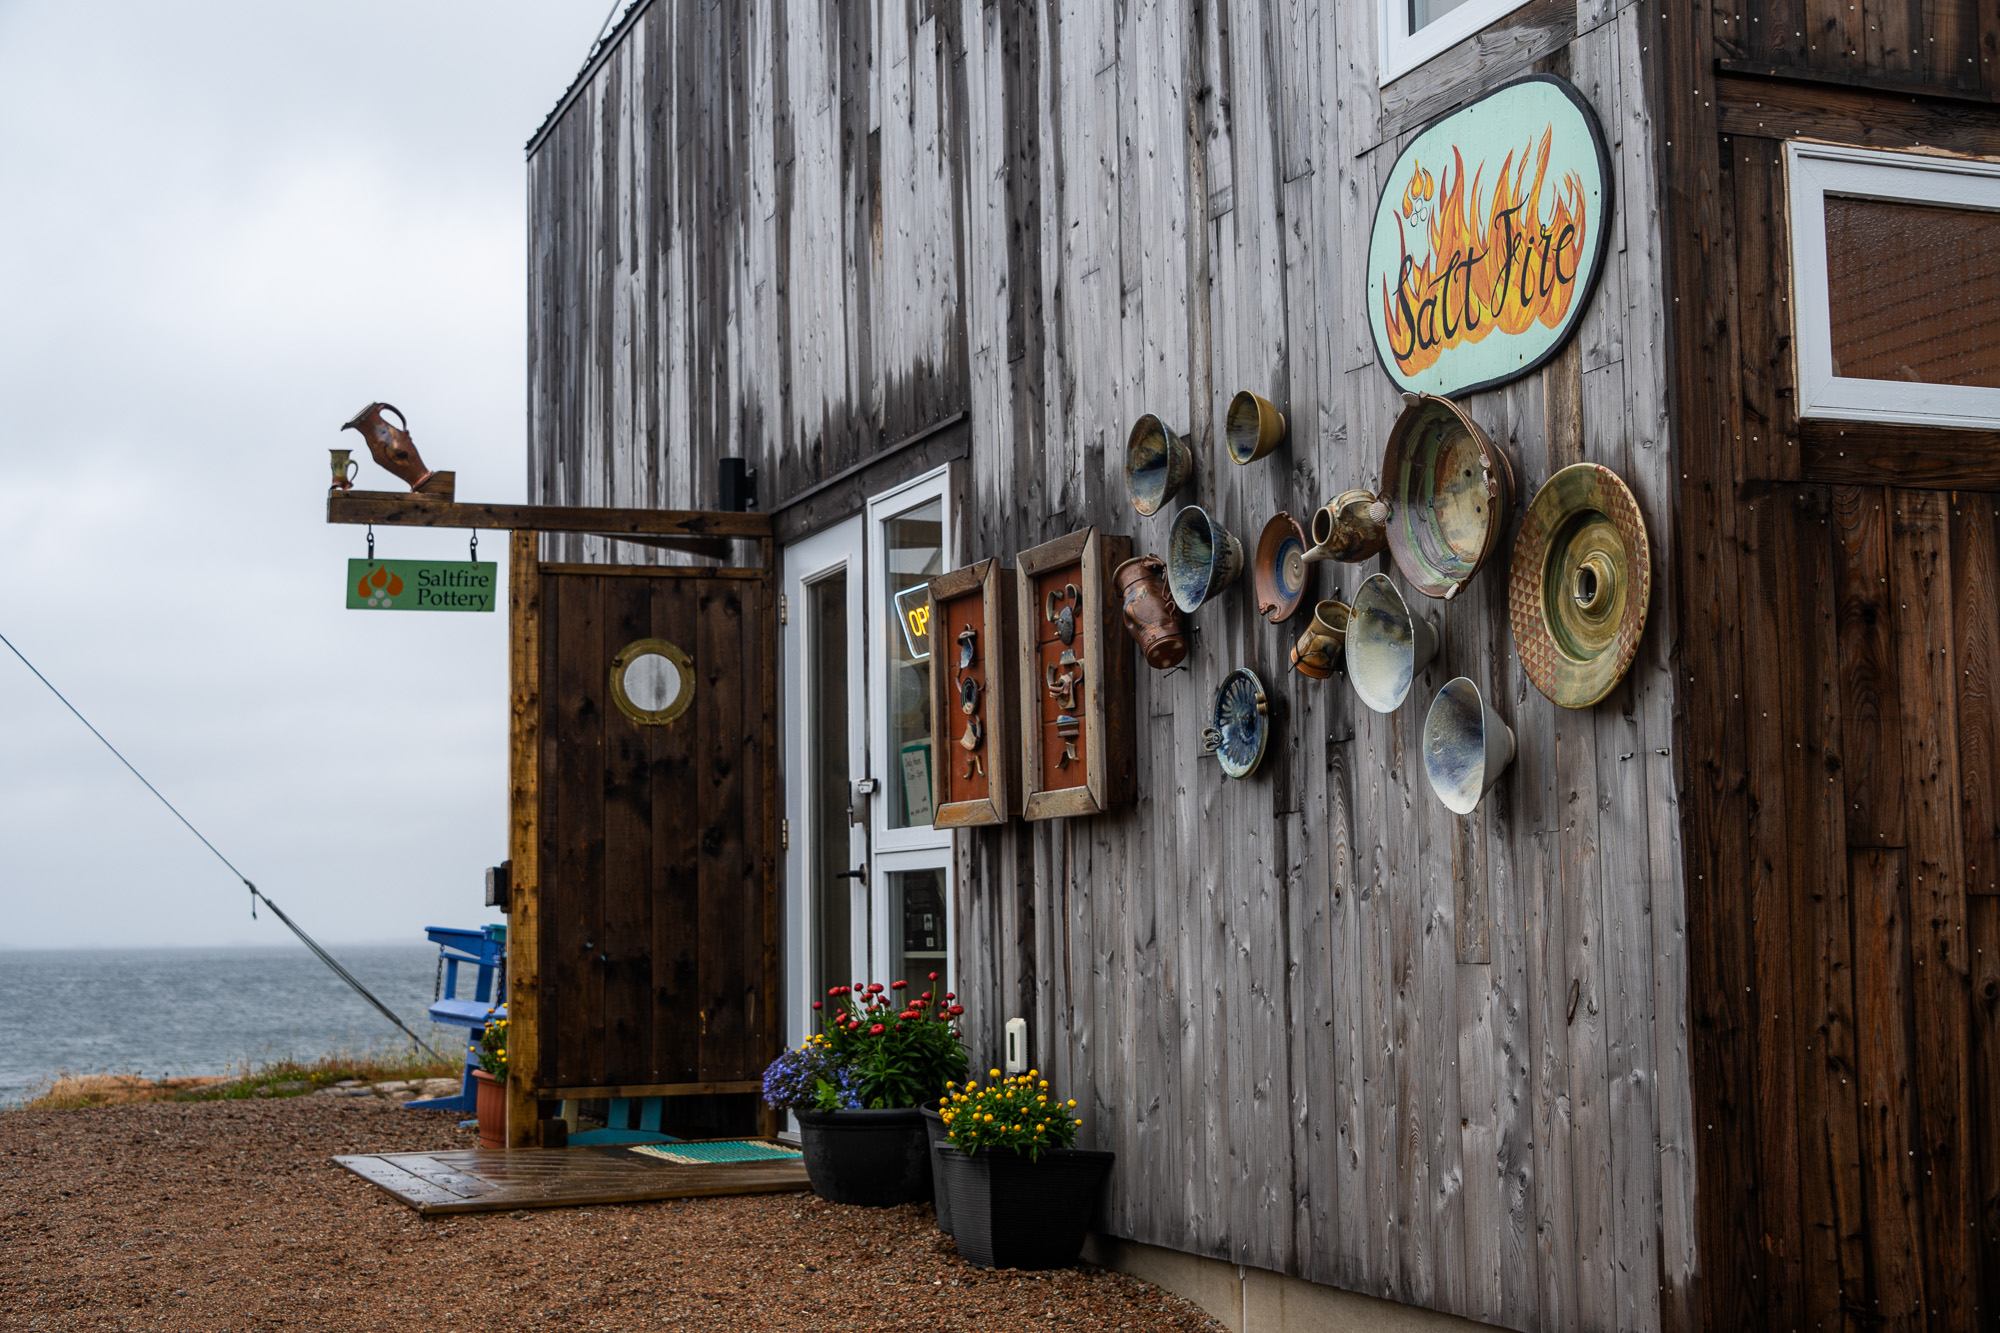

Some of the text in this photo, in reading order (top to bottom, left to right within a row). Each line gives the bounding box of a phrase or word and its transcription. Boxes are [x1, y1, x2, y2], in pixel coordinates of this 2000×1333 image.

[1391, 193, 1577, 361] Salt Fire
[418, 569, 489, 587] Saltfire
[417, 588, 489, 611] Pottery
[908, 605, 929, 636] OP
